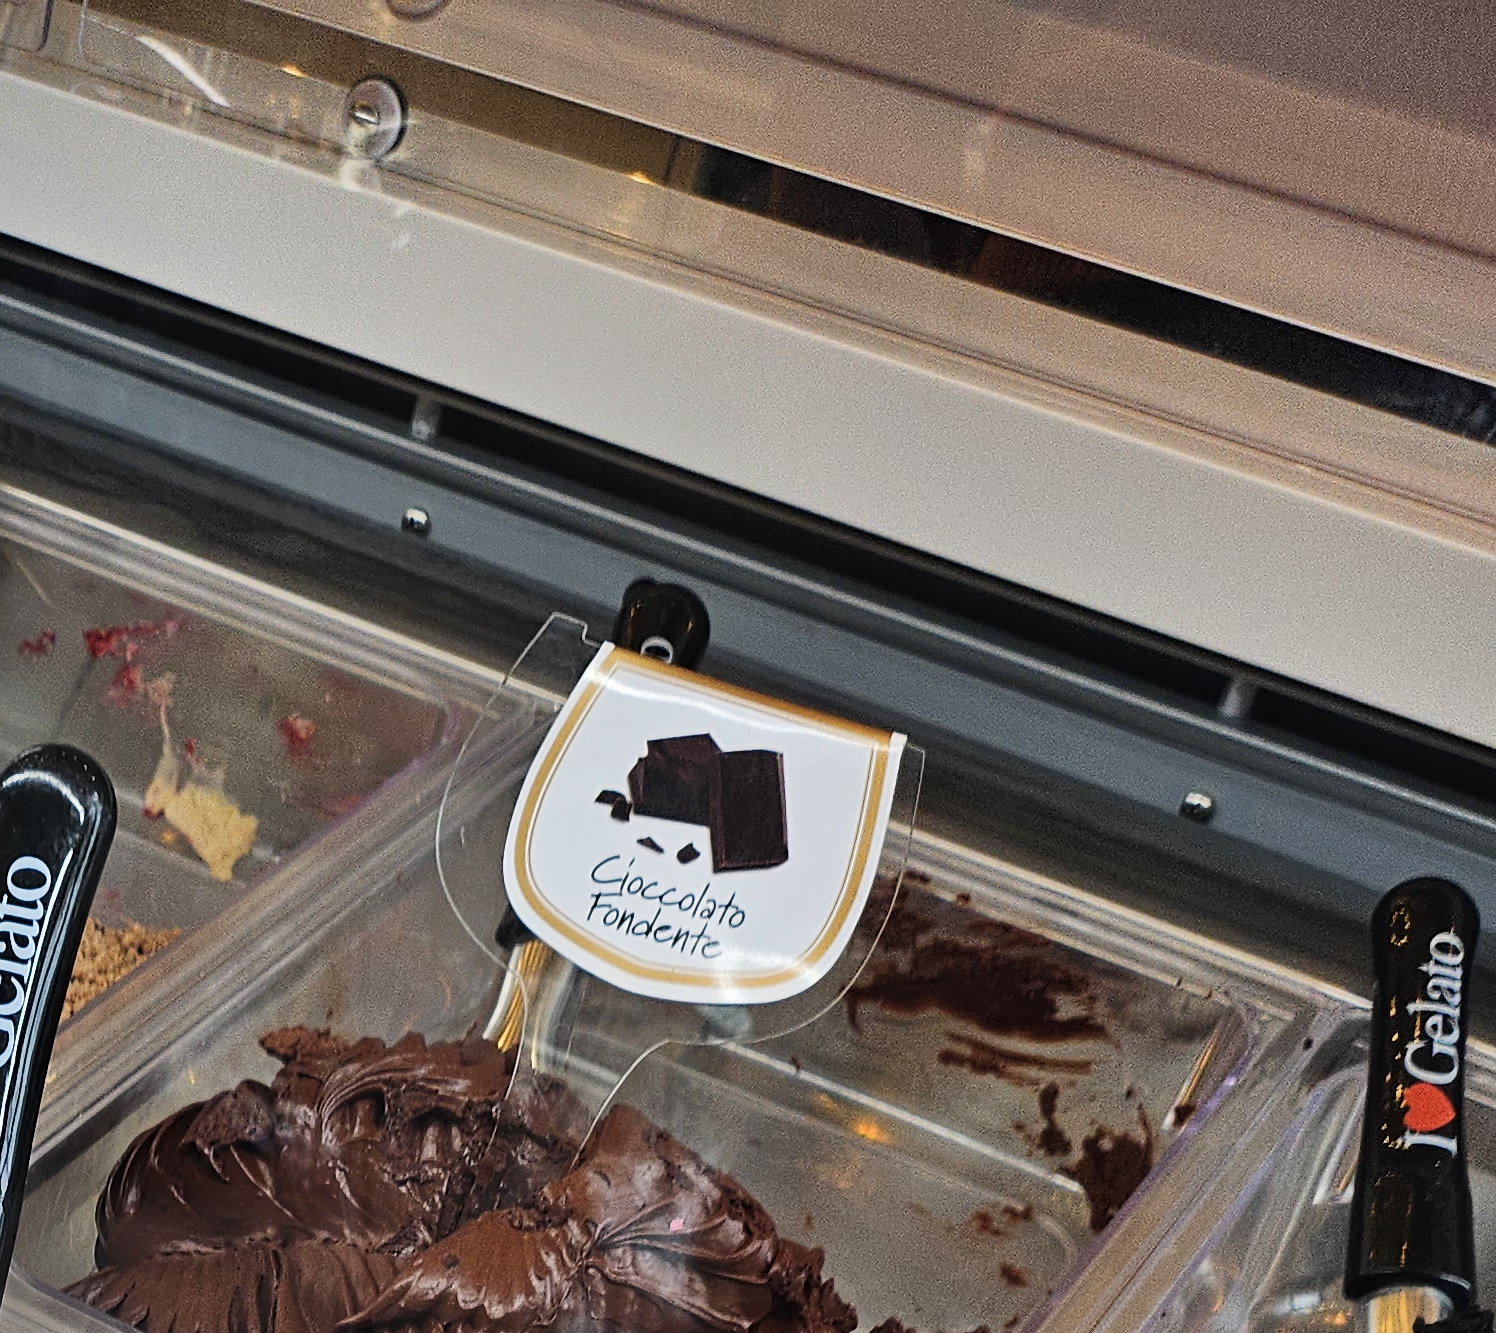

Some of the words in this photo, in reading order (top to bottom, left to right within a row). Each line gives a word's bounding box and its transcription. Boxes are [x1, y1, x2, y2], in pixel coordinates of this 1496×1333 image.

[585, 889, 724, 960] Fondente
[590, 853, 746, 930] Cioccolato
[1404, 930, 1465, 1086] Gelato
[1404, 1131, 1458, 1159] I
